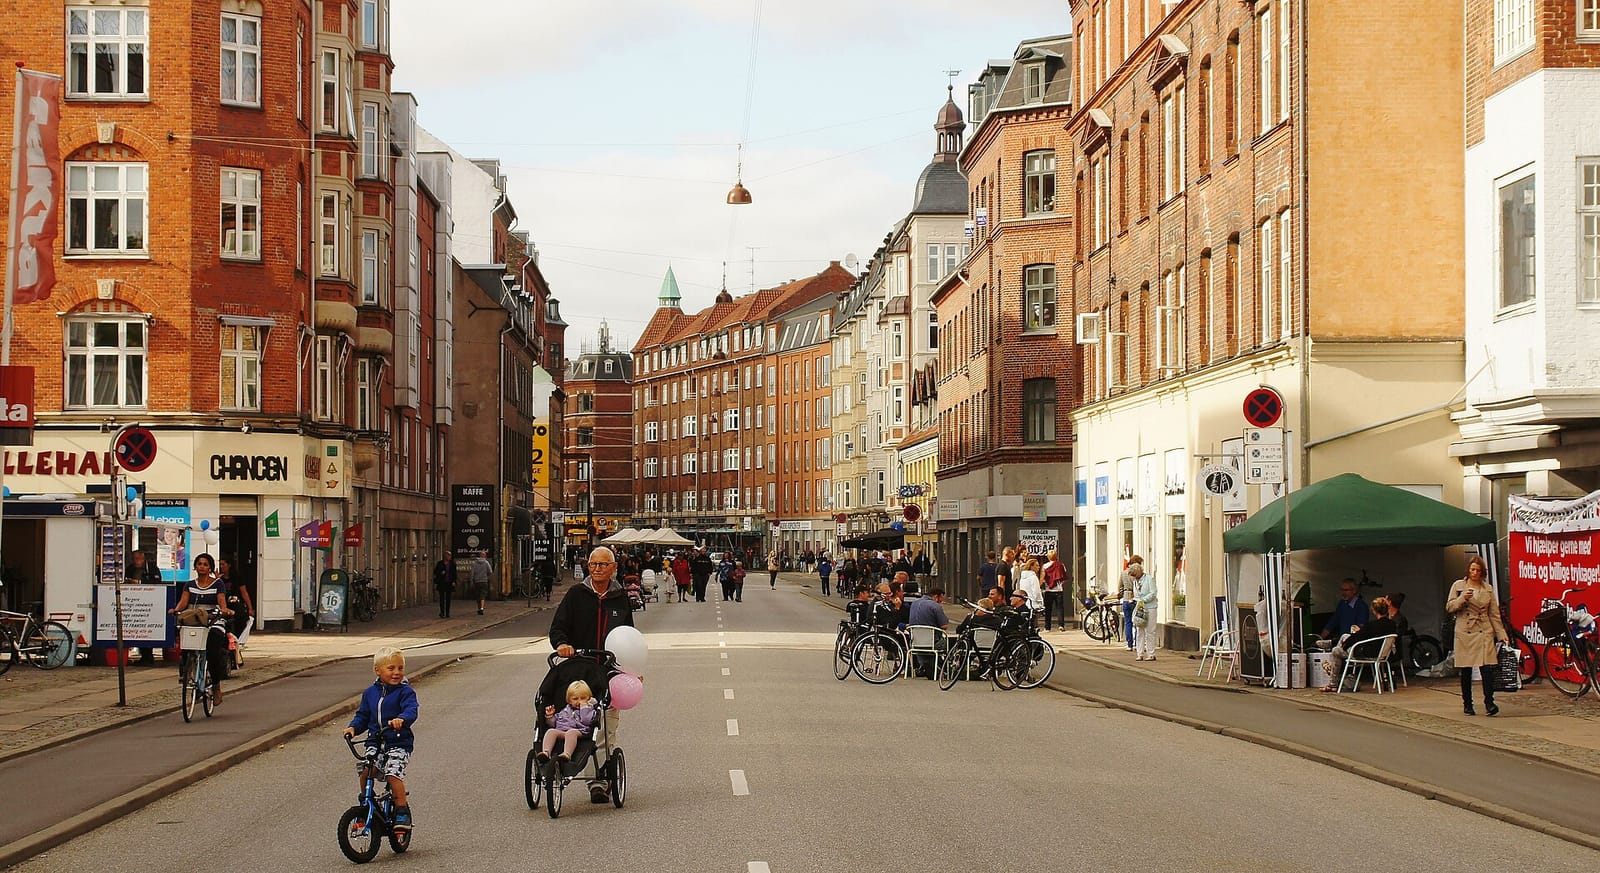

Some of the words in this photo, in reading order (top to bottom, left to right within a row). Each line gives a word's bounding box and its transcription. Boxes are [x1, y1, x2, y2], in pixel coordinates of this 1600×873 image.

[210, 455, 287, 481] CHANCEN
[1525, 536, 1532, 554] Vi
[1533, 535, 1559, 557] hjælper
[1560, 540, 1578, 558] gerne
[1578, 536, 1592, 555] med
[1519, 561, 1537, 579] flotte
[1538, 565, 1548, 584] og
[1549, 562, 1570, 585] billige
[326, 596, 338, 606] 16
[1523, 621, 1547, 644] rekla
